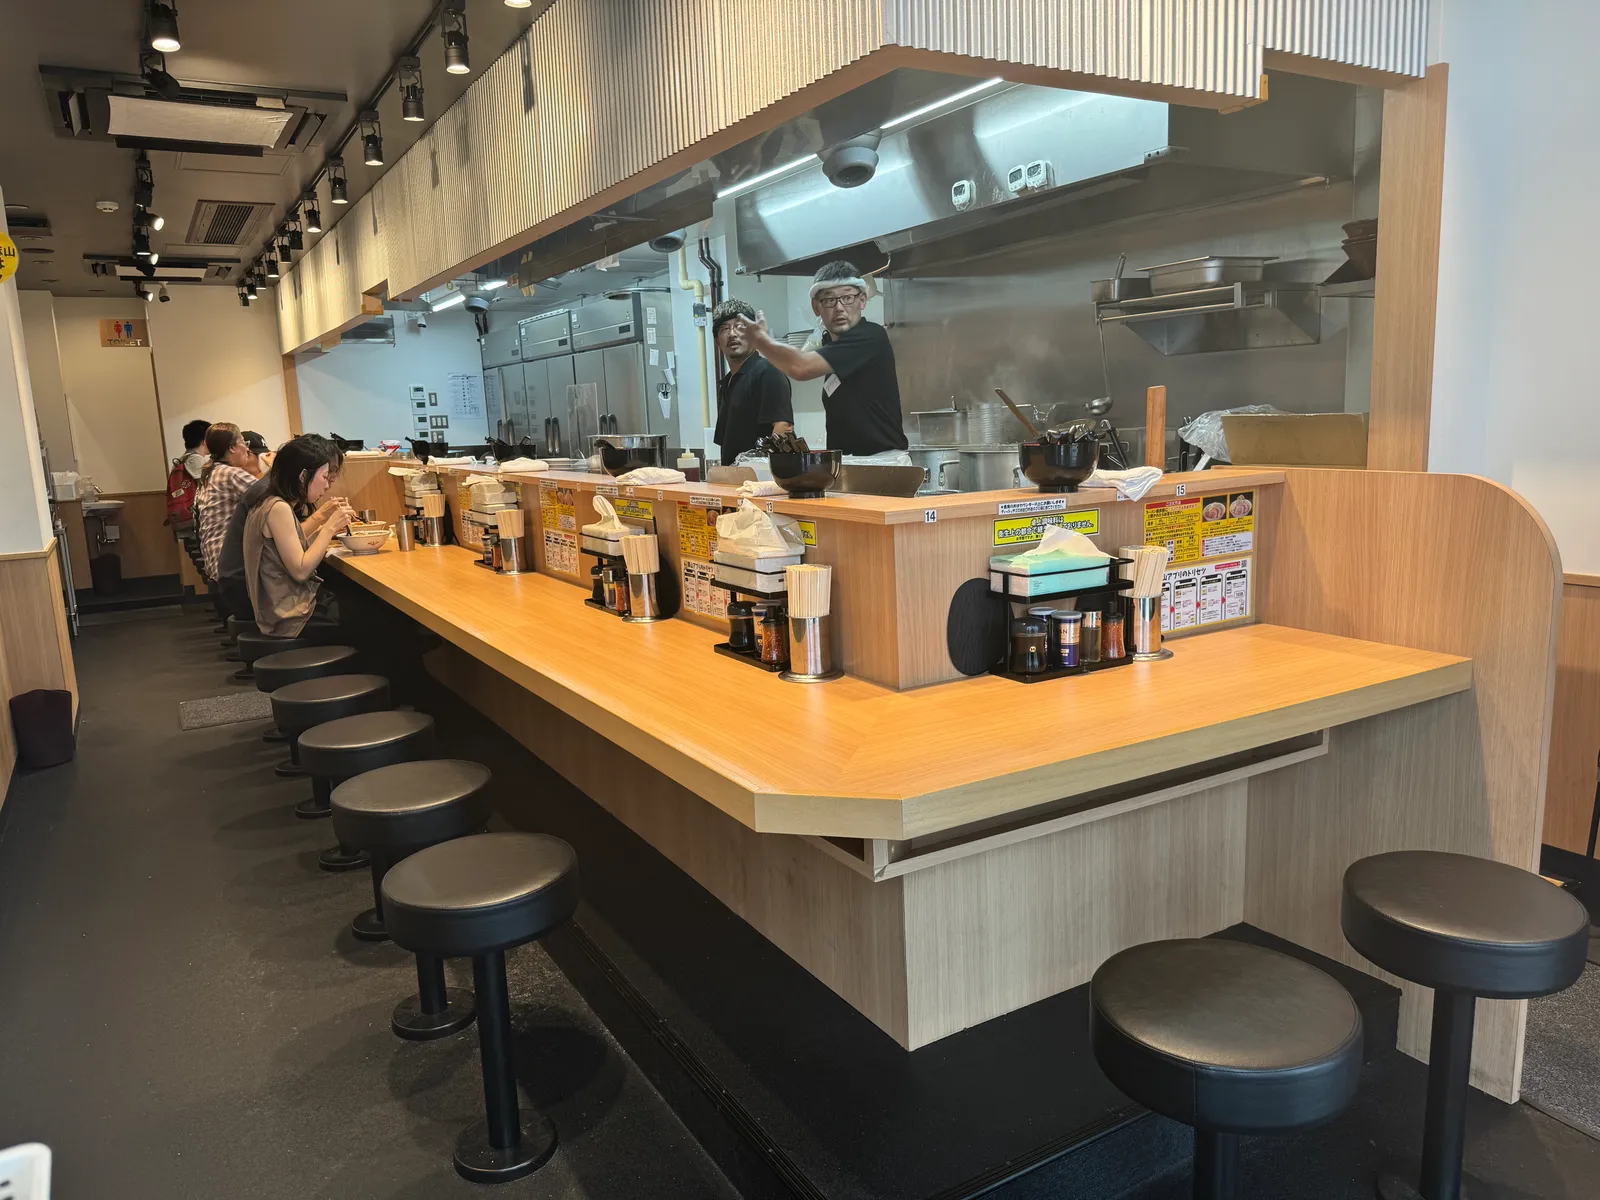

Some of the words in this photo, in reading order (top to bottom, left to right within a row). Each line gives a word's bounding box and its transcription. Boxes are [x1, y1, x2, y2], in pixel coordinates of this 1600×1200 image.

[107, 338, 142, 346] TOILET
[1177, 485, 1185, 496] 15
[766, 502, 773, 512] 13
[926, 511, 936, 522] 14
